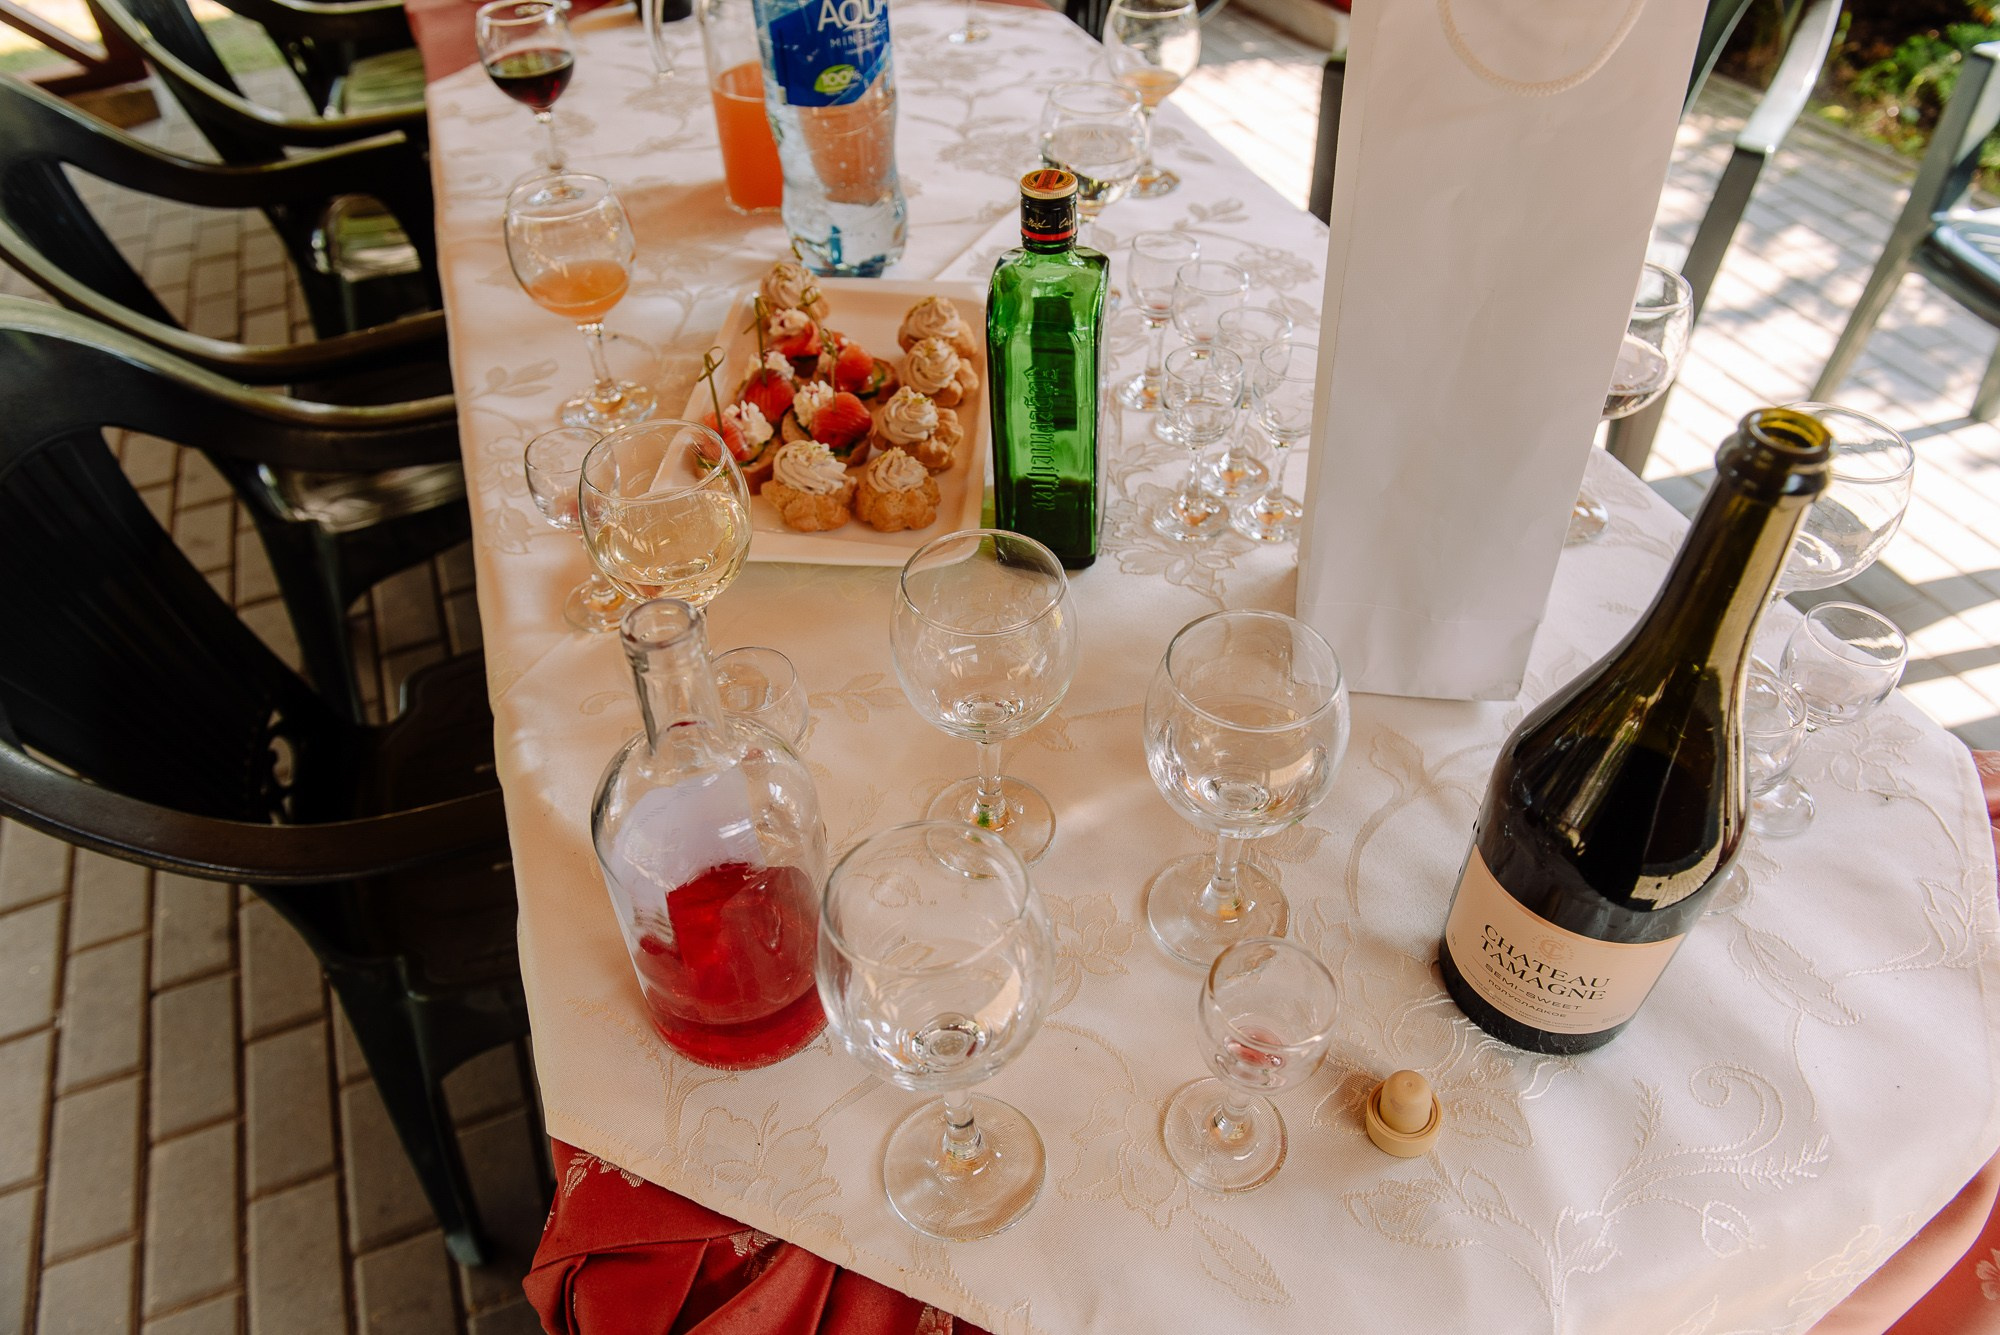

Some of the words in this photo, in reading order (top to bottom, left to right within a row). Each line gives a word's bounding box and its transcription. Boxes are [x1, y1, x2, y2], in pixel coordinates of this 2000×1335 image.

[821, 70, 863, 86] 100%
[1481, 935, 1607, 1001] TAMAGNE
[1484, 924, 1611, 989] CHATEAU
[1484, 963, 1583, 1010] SEMI-SWEET
[1488, 979, 1567, 1018] ПОЛУСЛАДКОЕ
